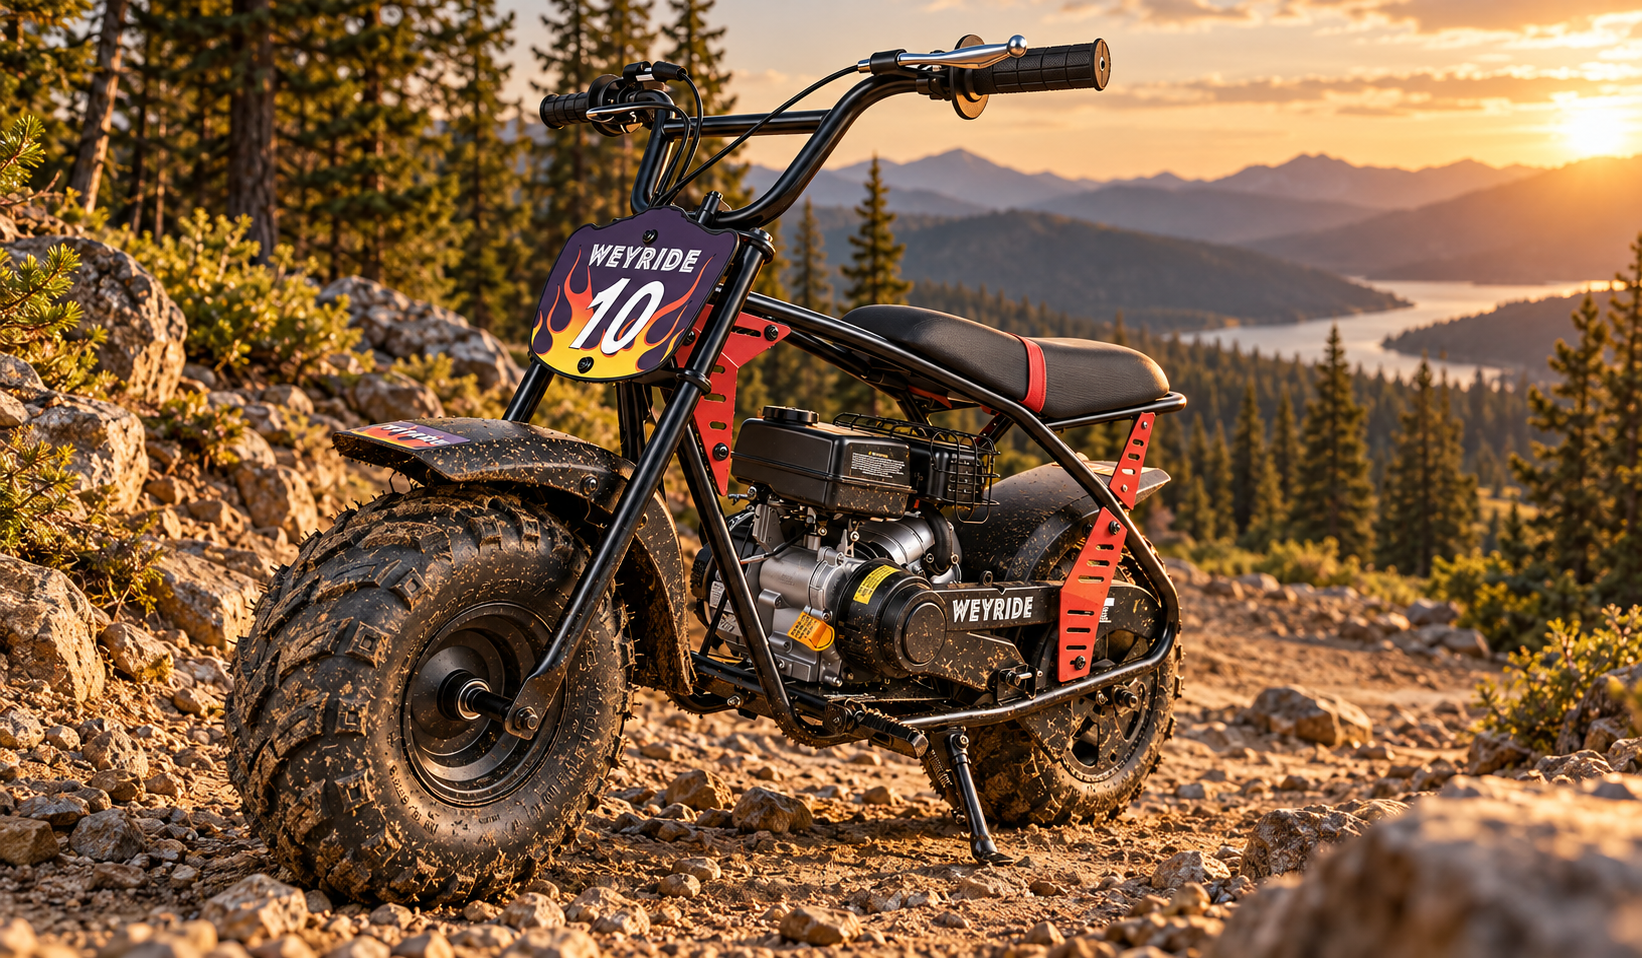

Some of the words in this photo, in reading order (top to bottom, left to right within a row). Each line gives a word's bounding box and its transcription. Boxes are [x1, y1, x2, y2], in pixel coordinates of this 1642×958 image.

[589, 243, 702, 273] WEYRIDE
[569, 278, 665, 354] 10
[952, 597, 1034, 623] WEYRIDE
